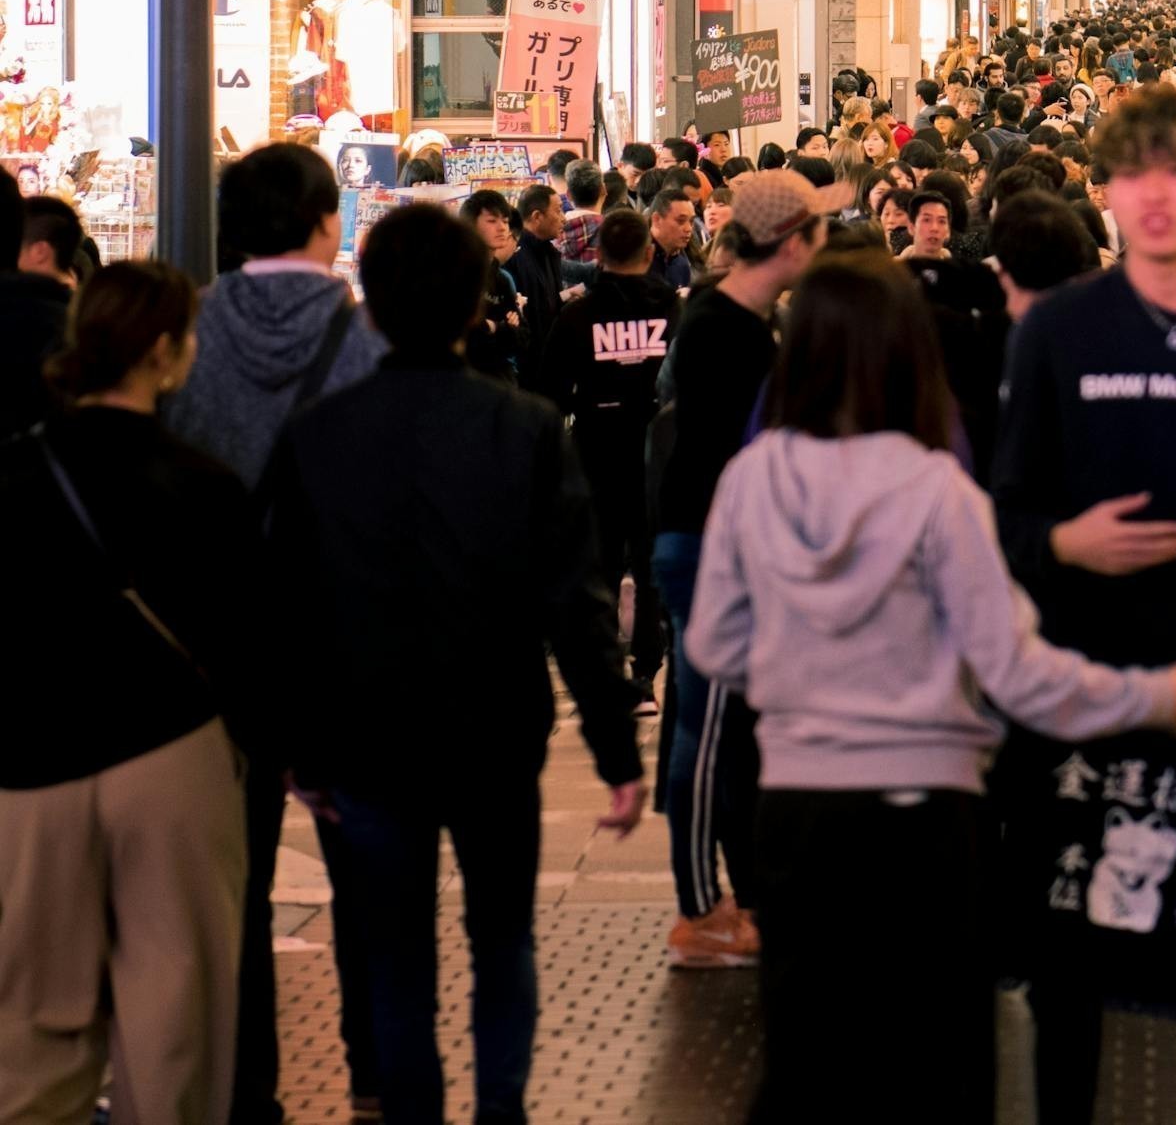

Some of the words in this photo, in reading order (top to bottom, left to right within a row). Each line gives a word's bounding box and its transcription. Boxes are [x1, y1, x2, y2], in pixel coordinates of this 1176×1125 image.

[217, 68, 251, 88] LA
[733, 52, 781, 94] ¥900
[592, 318, 668, 353] NHIZ
[1079, 372, 1147, 401] BMW
